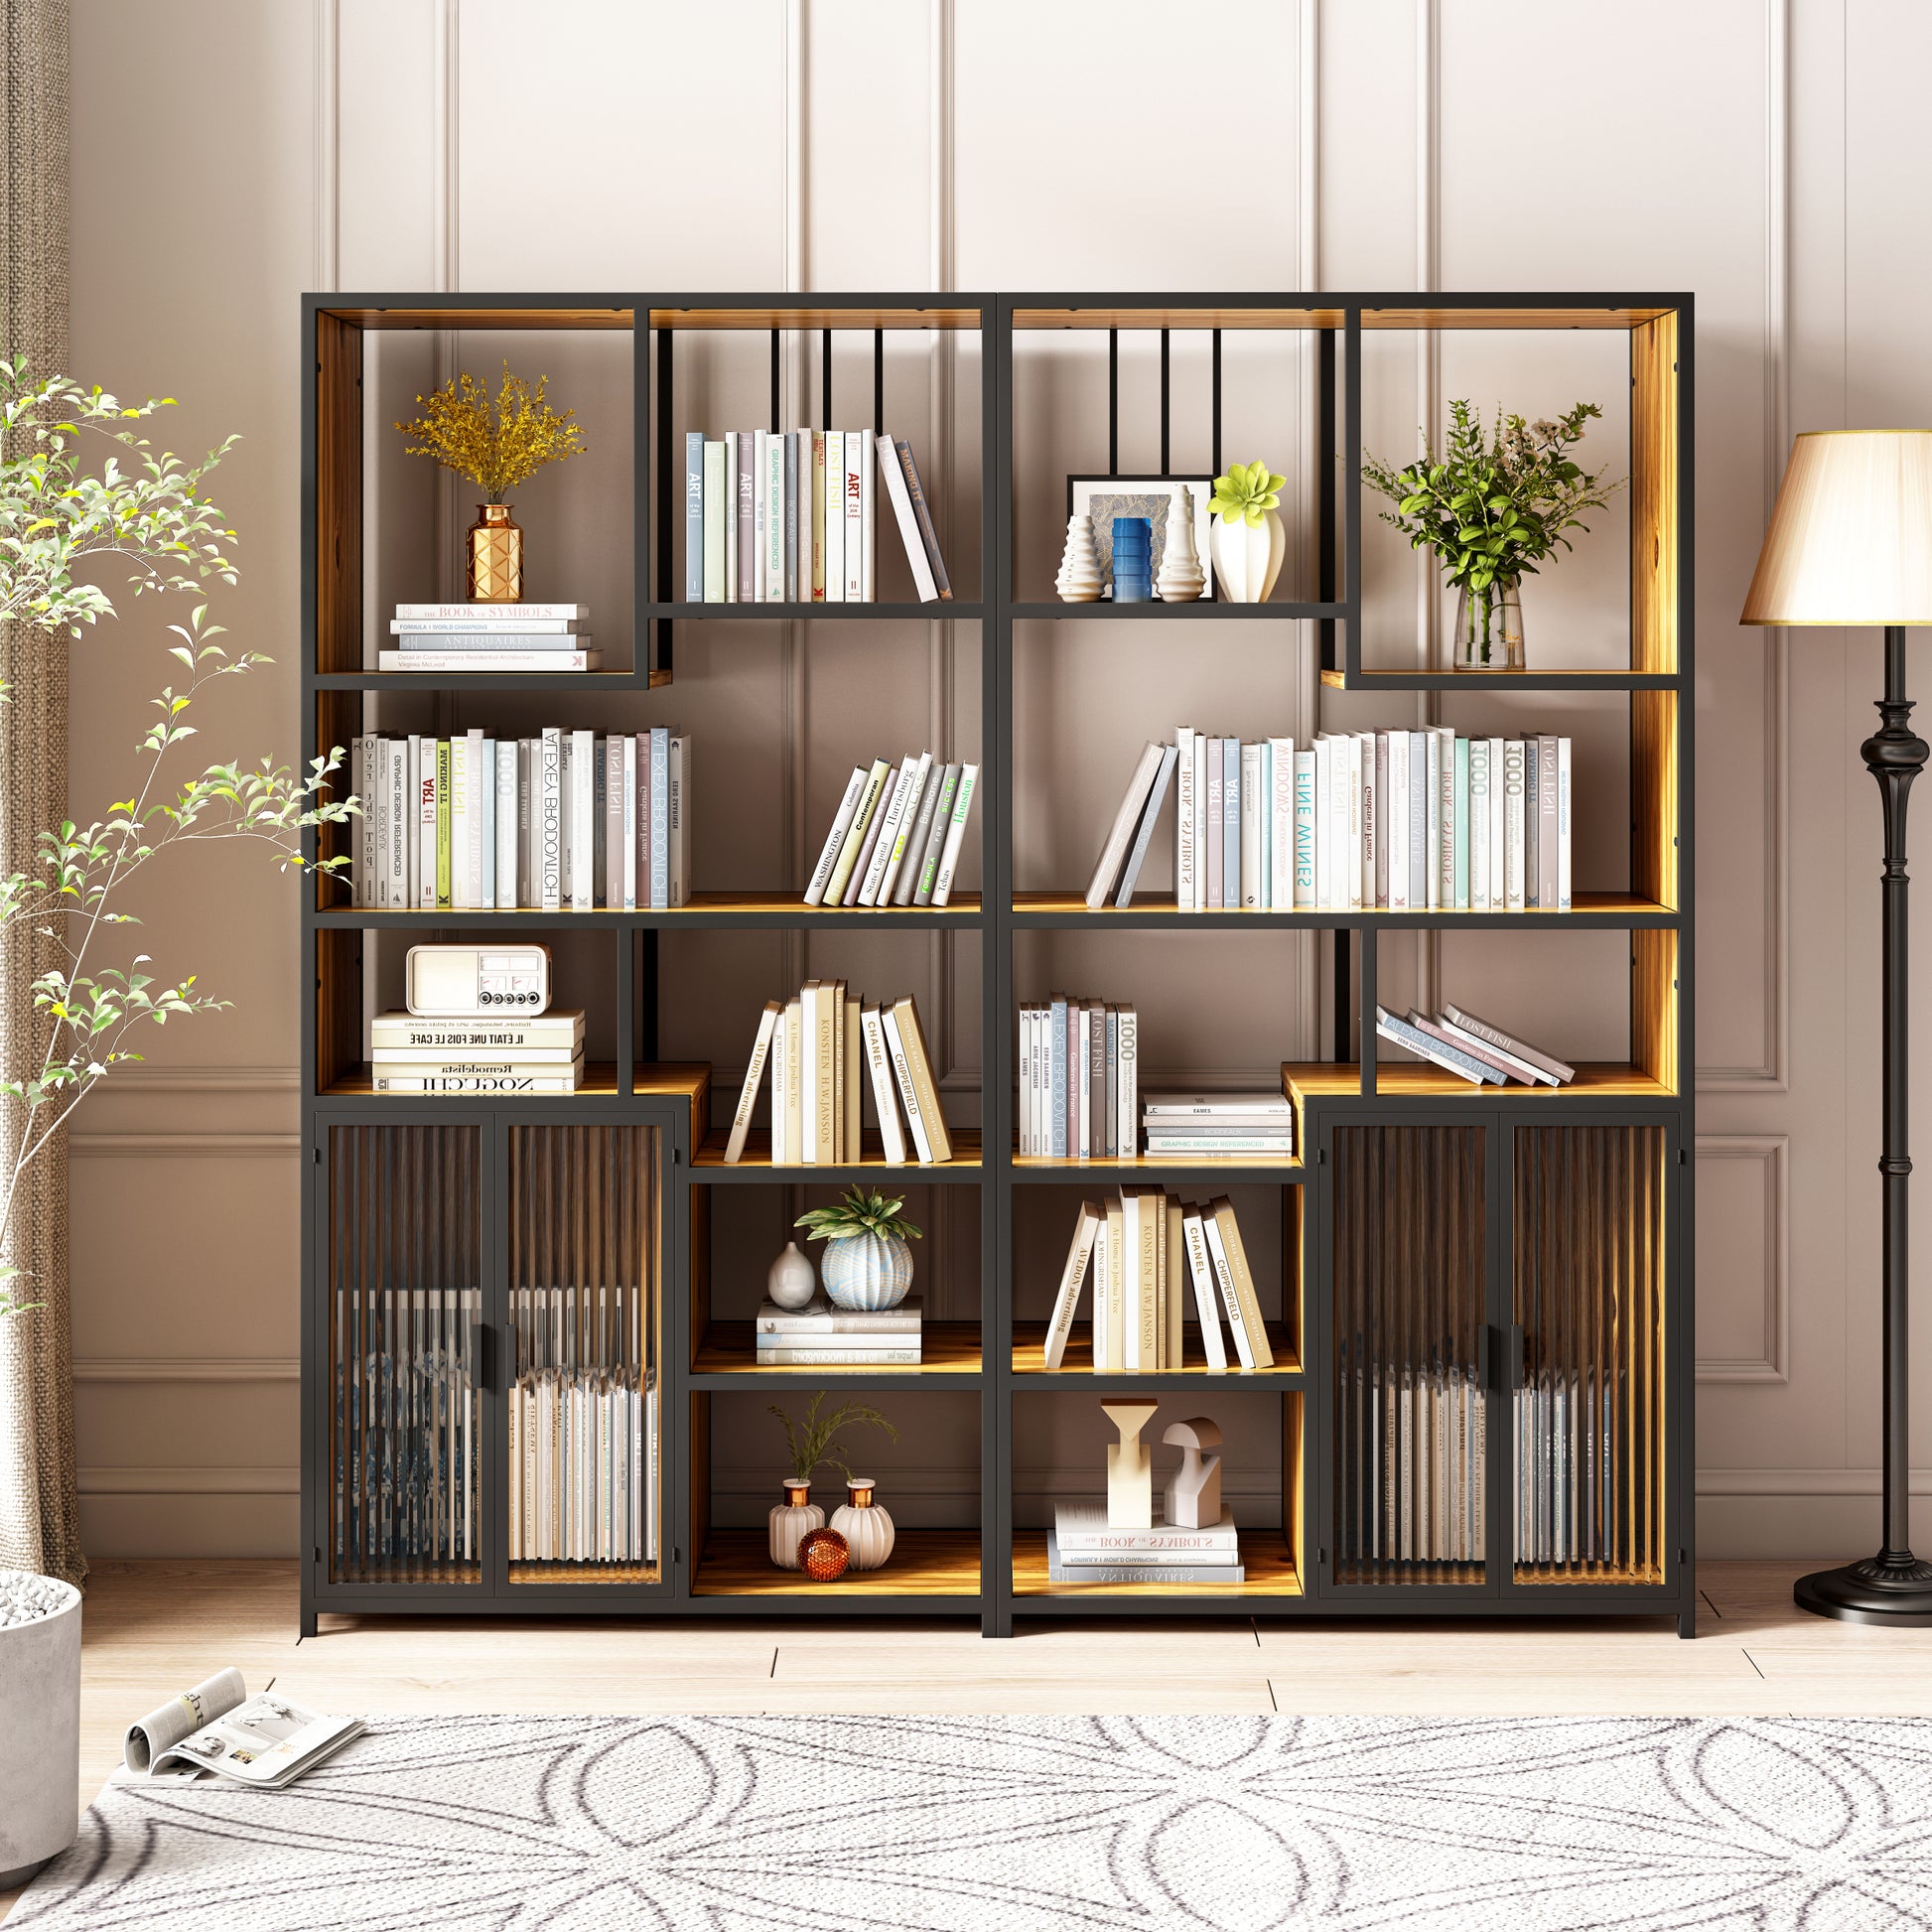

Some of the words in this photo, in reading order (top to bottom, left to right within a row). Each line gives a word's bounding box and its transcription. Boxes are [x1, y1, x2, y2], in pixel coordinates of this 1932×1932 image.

[689, 473, 701, 499] ART
[741, 473, 753, 499] ART
[848, 473, 860, 498] ART
[900, 449, 918, 489] MAKING
[912, 489, 922, 501] IT
[439, 607, 476, 618] BOOK
[488, 607, 552, 618] SYMBOLS
[444, 635, 531, 645] ANTIQUAIRES
[887, 768, 914, 826] Harrisburg
[919, 776, 940, 825] Brisbane
[953, 779, 973, 824] Houston
[892, 834, 906, 863] TED
[921, 857, 937, 895] FORMULA
[934, 825, 943, 843] FOR
[940, 776, 956, 813] SUCCESS
[814, 829, 842, 889] WASHINGTON
[866, 873, 878, 895] State
[875, 842, 889, 872] Capital
[789, 1033, 798, 1053] Home
[821, 1020, 830, 1069] KONSTEN
[867, 1021, 883, 1069] CHANEL
[1053, 1007, 1065, 1058] ALEXEY
[1092, 1013, 1103, 1046] LOST
[1120, 1019, 1135, 1061] 1000
[1387, 1019, 1428, 1043] ALEXEY
[1430, 1039, 1499, 1080] BRODOVITCH
[1458, 1016, 1487, 1037] LOST
[1487, 1030, 1512, 1049] FISH
[750, 1041, 766, 1079] AVEDON
[1092, 1049, 1103, 1077] FISH
[1452, 1038, 1475, 1055] Gardens
[1484, 1054, 1505, 1069] France
[788, 1065, 799, 1090] Joshua
[895, 1053, 917, 1115] CHIPPERFIELD
[735, 1081, 755, 1127] advertising
[1053, 1062, 1065, 1150] BRODOVITCH
[1071, 1247, 1088, 1286] AVEDON
[1144, 1225, 1153, 1276] KONSTEN
[1189, 1227, 1205, 1275] CHANEL
[1057, 1287, 1077, 1333] advertising
[1217, 1259, 1240, 1321] CHIPPERFIELD
